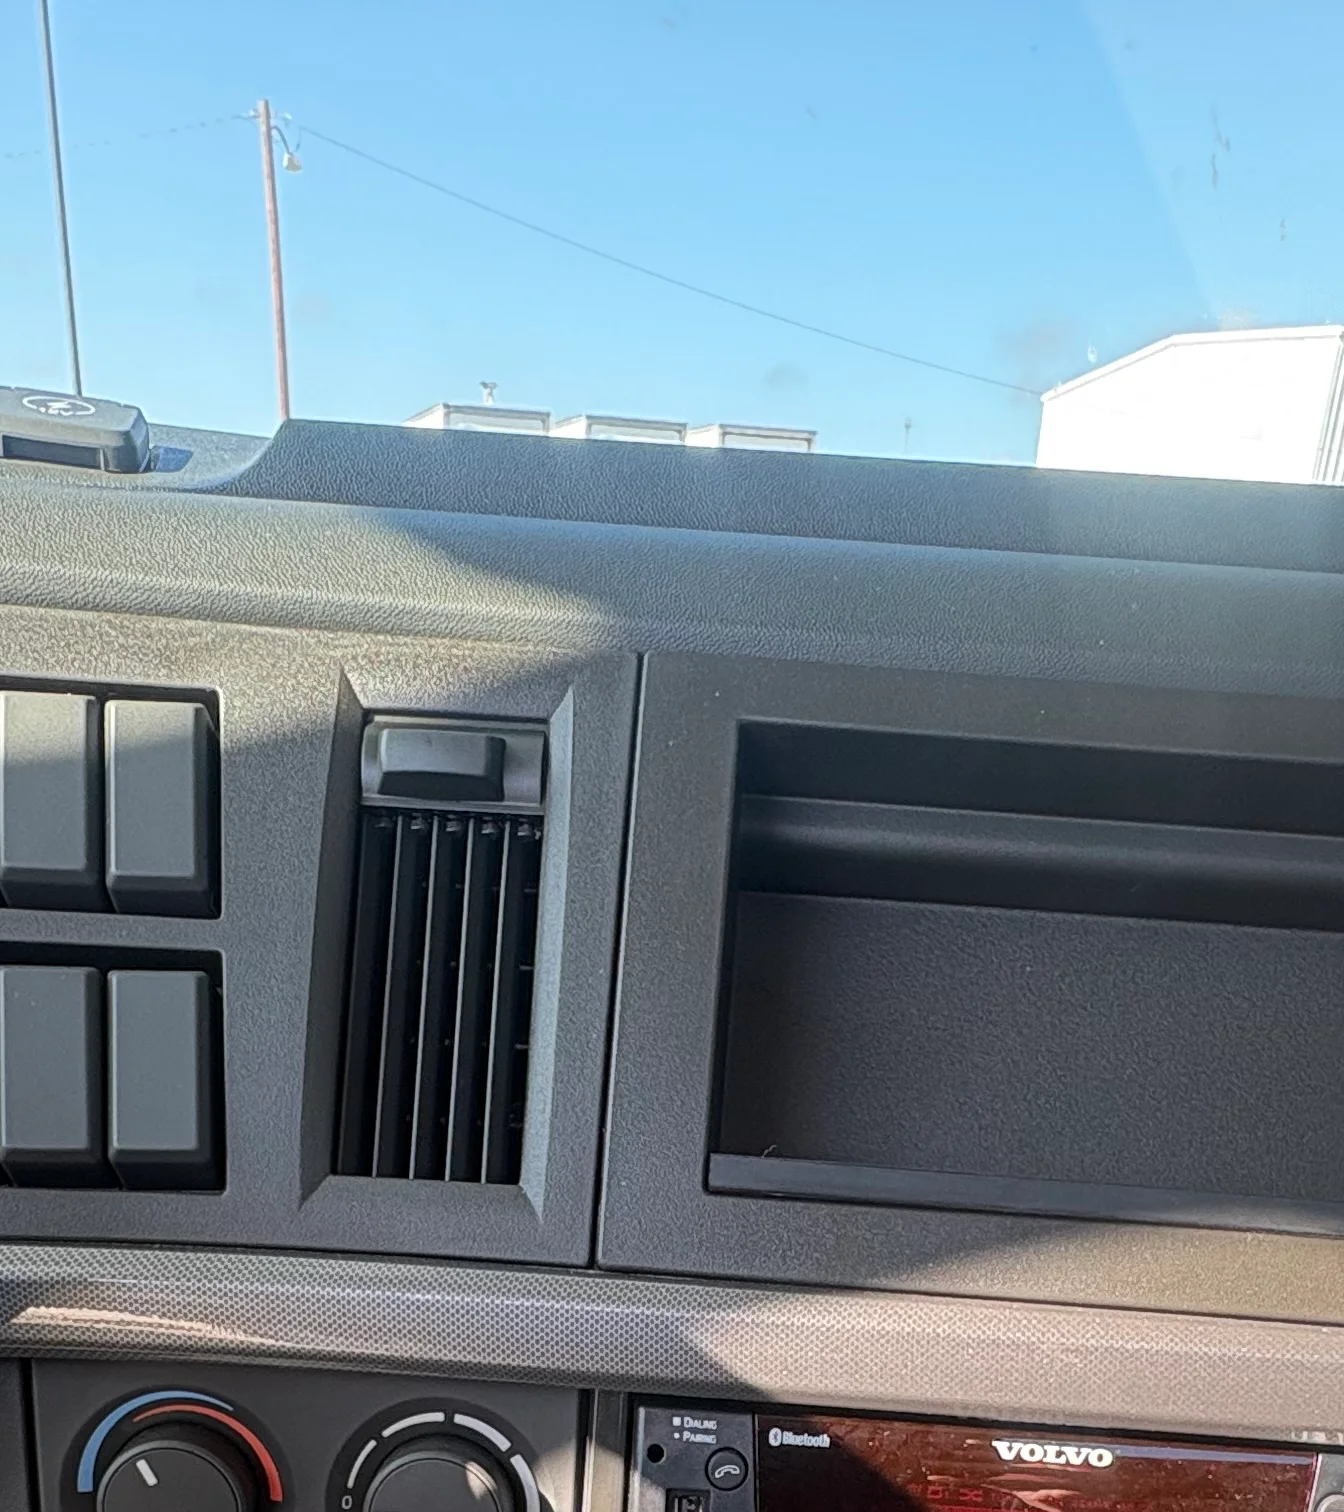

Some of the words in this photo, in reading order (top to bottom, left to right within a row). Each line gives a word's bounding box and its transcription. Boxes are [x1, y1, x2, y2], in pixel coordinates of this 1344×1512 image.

[683, 1416, 717, 1430] DIALING
[683, 1431, 716, 1444] PAIRING
[782, 1431, 830, 1448] Bluetooth
[992, 1439, 1114, 1469] VOLVO
[341, 1495, 352, 1510] 0
